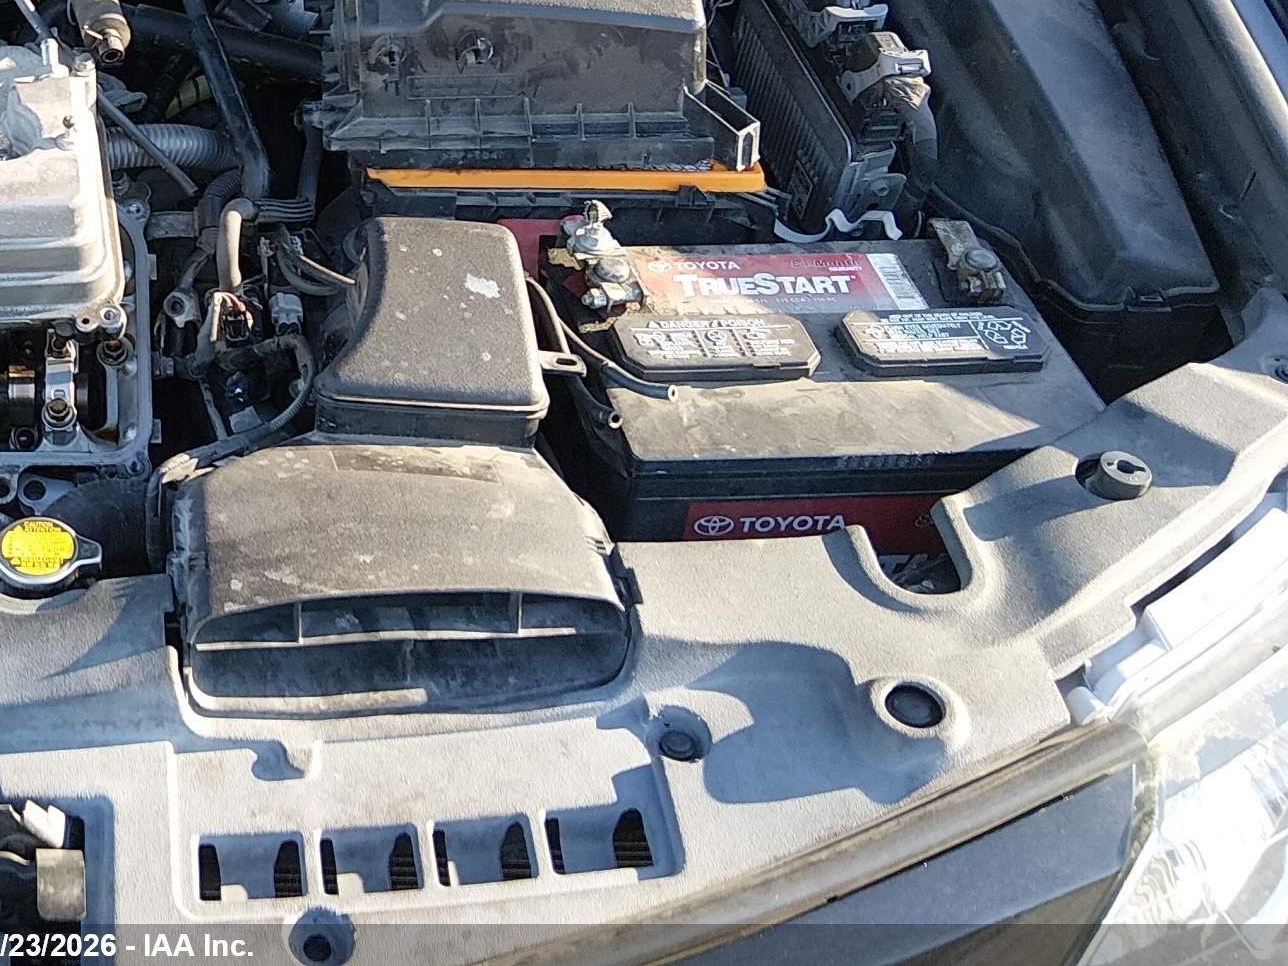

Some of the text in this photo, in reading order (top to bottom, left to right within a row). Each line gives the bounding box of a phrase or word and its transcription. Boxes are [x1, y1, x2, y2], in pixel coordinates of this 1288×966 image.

[675, 260, 740, 271] TOYOTA
[663, 320, 709, 330] DANGER
[720, 318, 766, 328] POISON
[740, 515, 846, 532] TOYOTA
